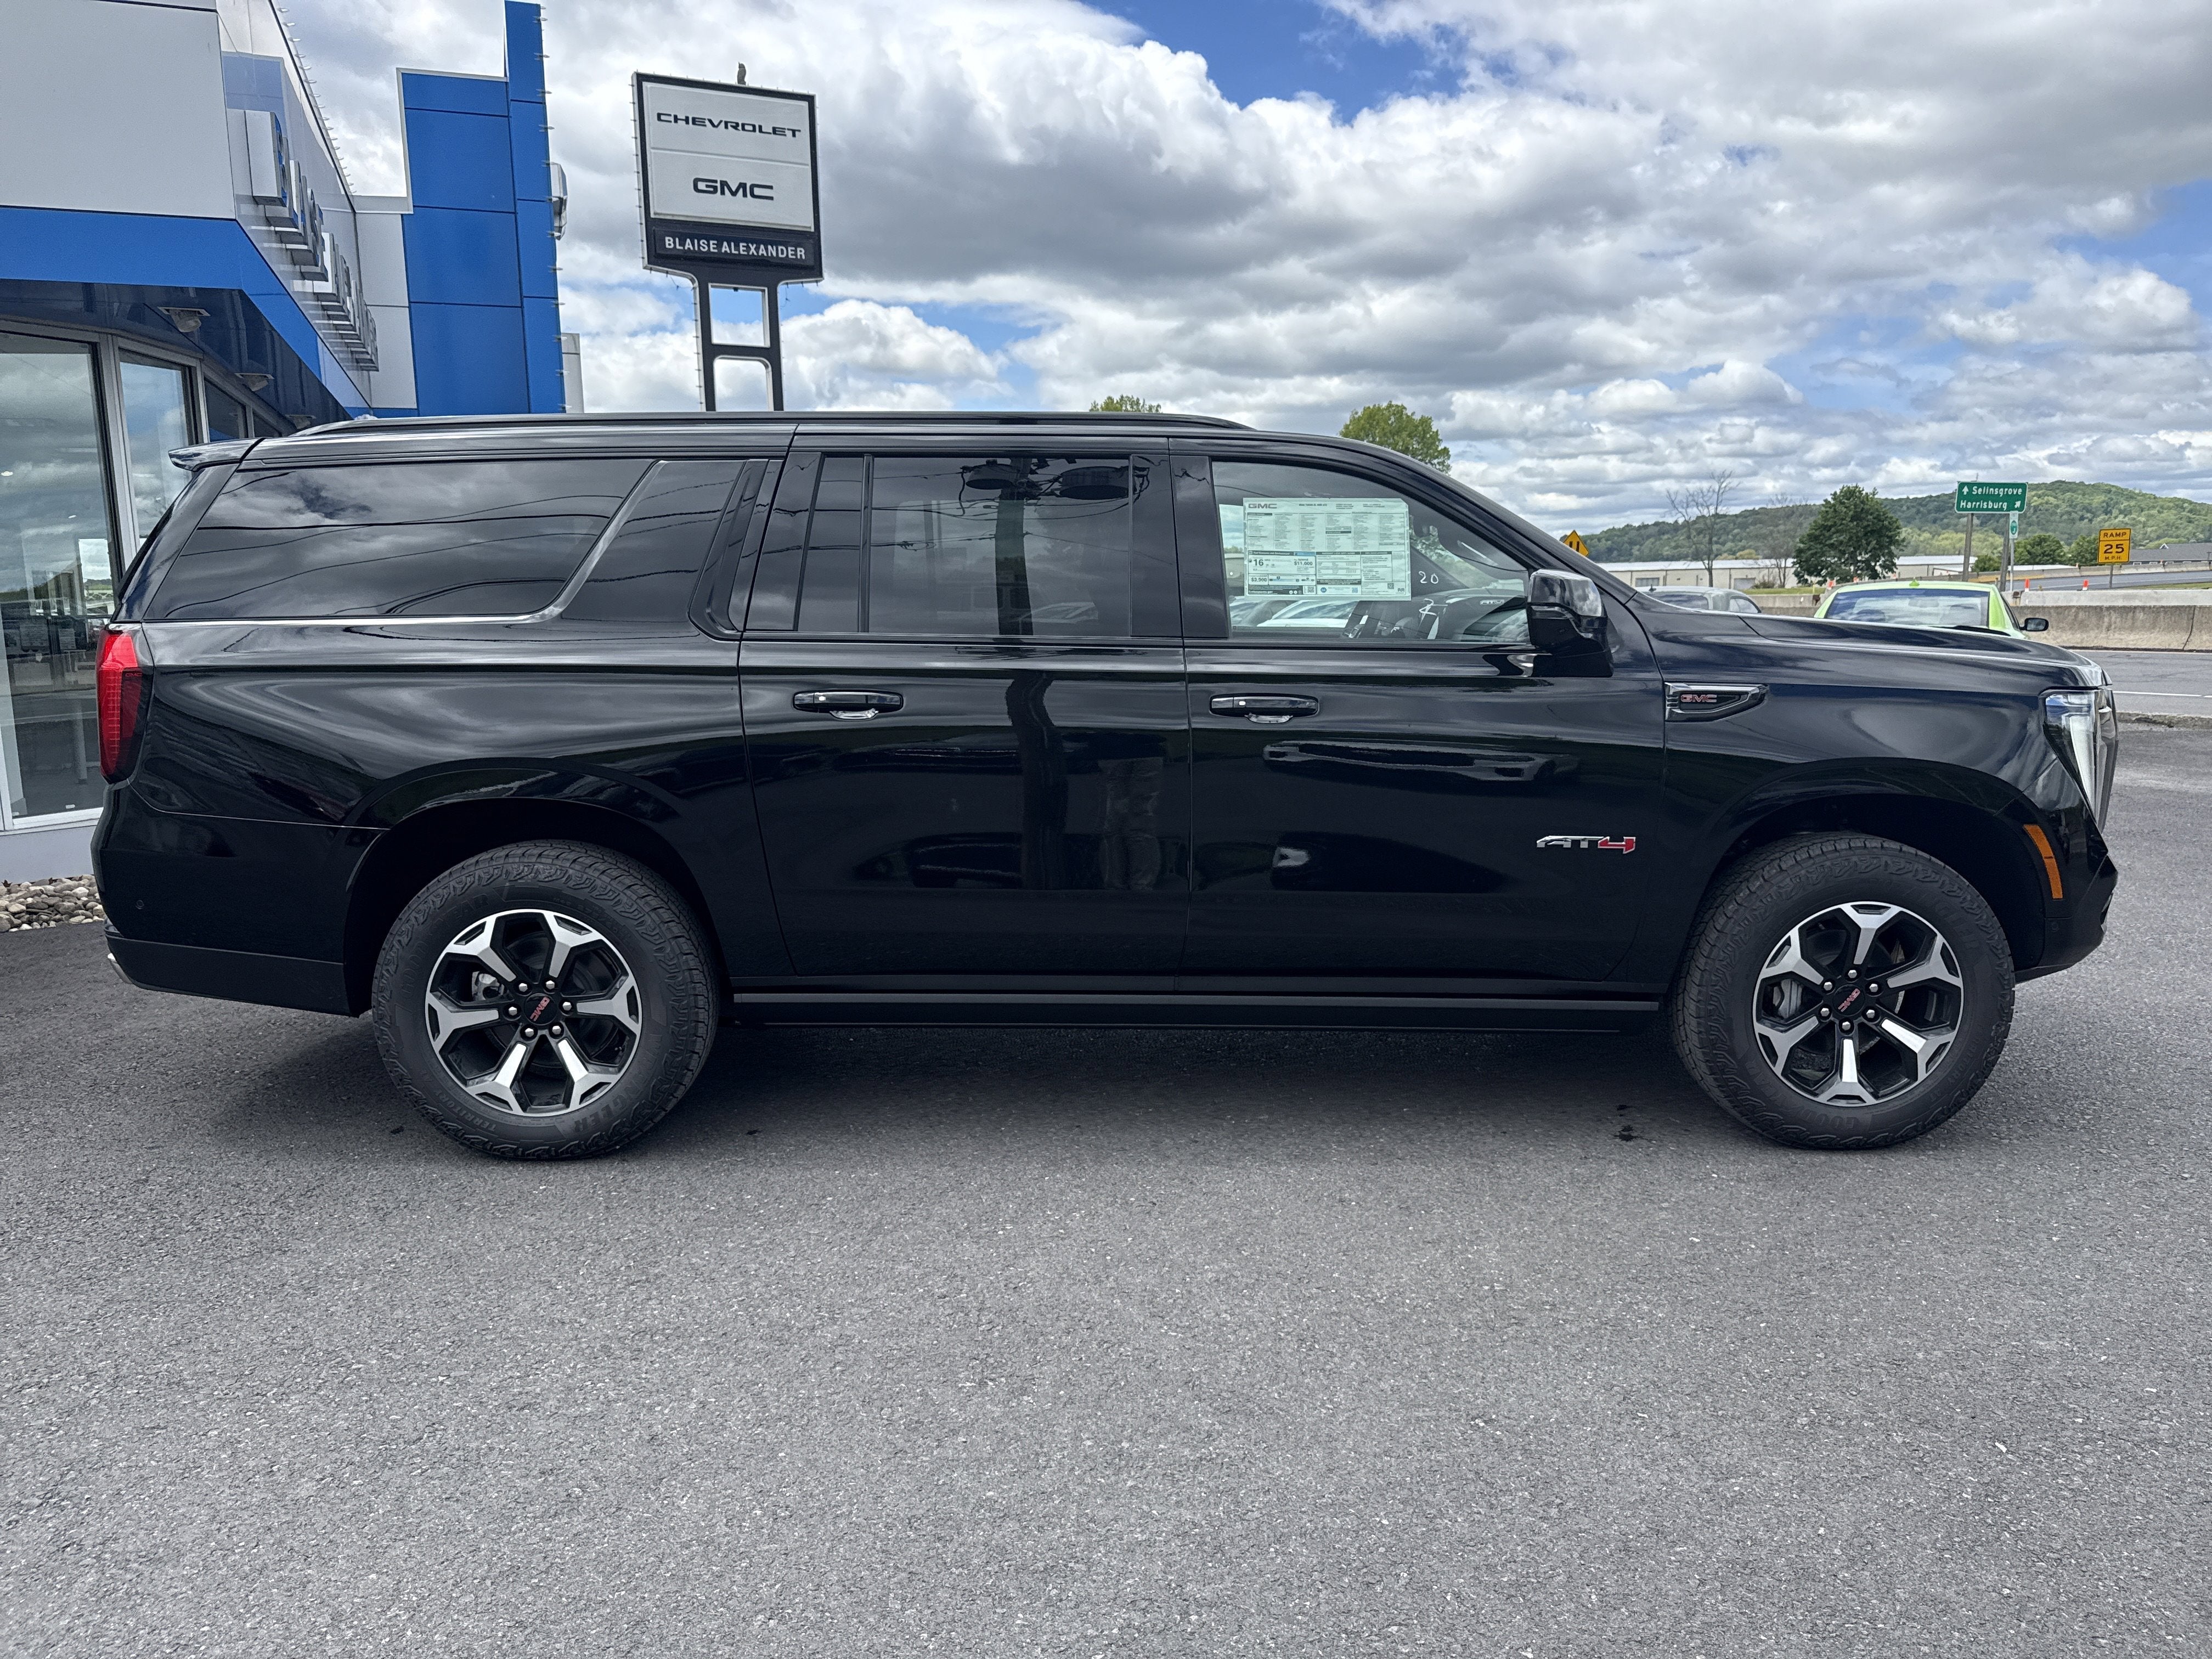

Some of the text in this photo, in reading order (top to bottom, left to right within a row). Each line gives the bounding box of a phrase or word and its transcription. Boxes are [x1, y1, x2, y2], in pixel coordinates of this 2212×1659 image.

[657, 112, 801, 138] CHEVROLET
[693, 177, 774, 200] GMC
[665, 236, 805, 259] BLAISE ALEXANDER
[1972, 486, 2022, 497] Selinsgrove
[1960, 500, 2007, 511] Harrisburg
[2104, 544, 2124, 554] 25
[1419, 571, 1438, 584] 20
[1680, 694, 1717, 702] GMC
[1537, 836, 1636, 854] AT4
[530, 996, 550, 1022] GMC
[1838, 988, 1861, 1012] GMC
